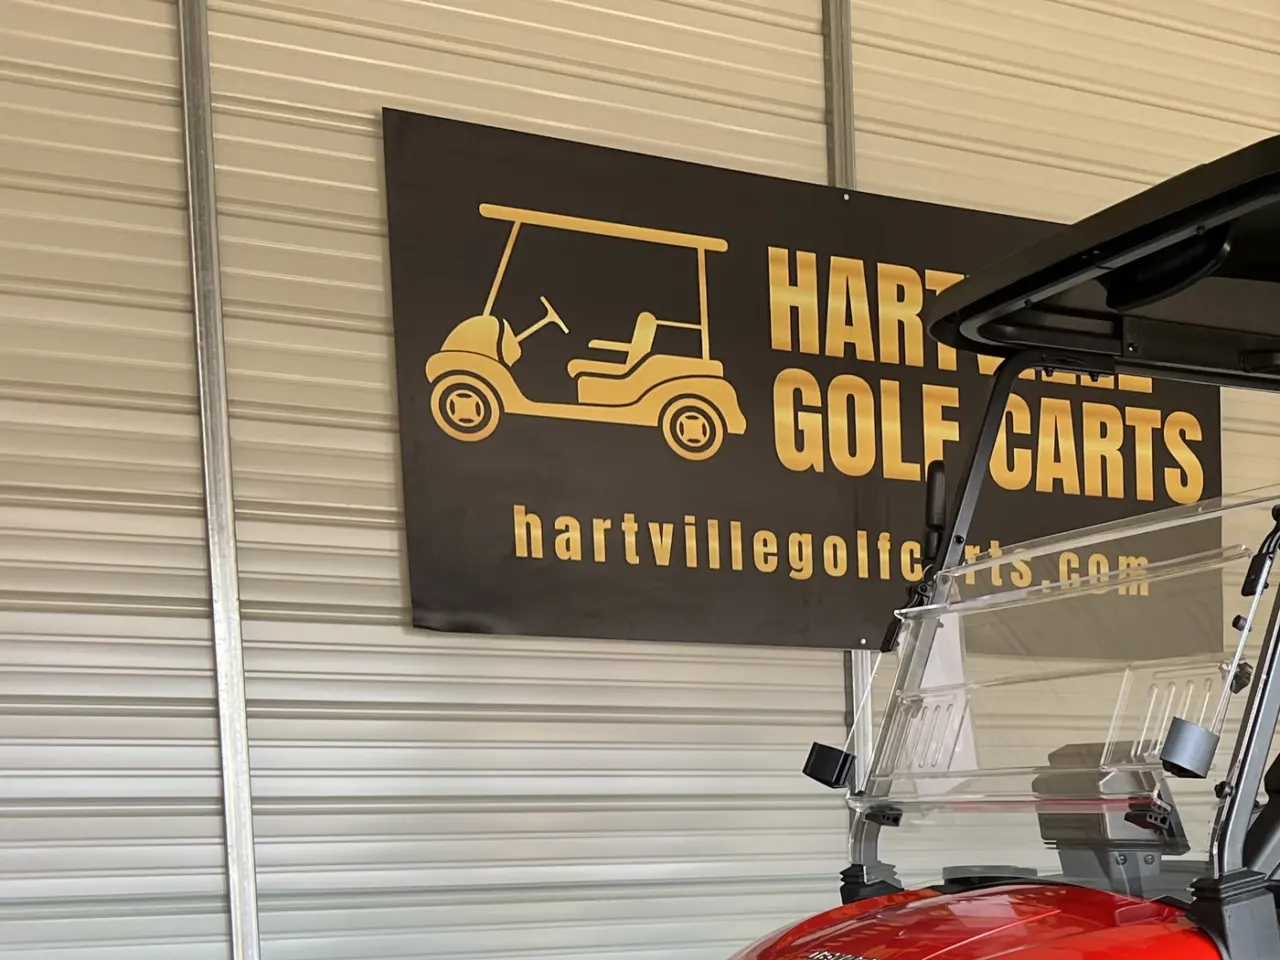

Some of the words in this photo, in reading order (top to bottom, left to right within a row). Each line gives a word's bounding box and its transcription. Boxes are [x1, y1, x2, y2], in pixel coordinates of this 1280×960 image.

[772, 367, 960, 482] GOLF
[989, 393, 1204, 505] CARTS
[513, 504, 1149, 595] hartvillegolfcrts.com
